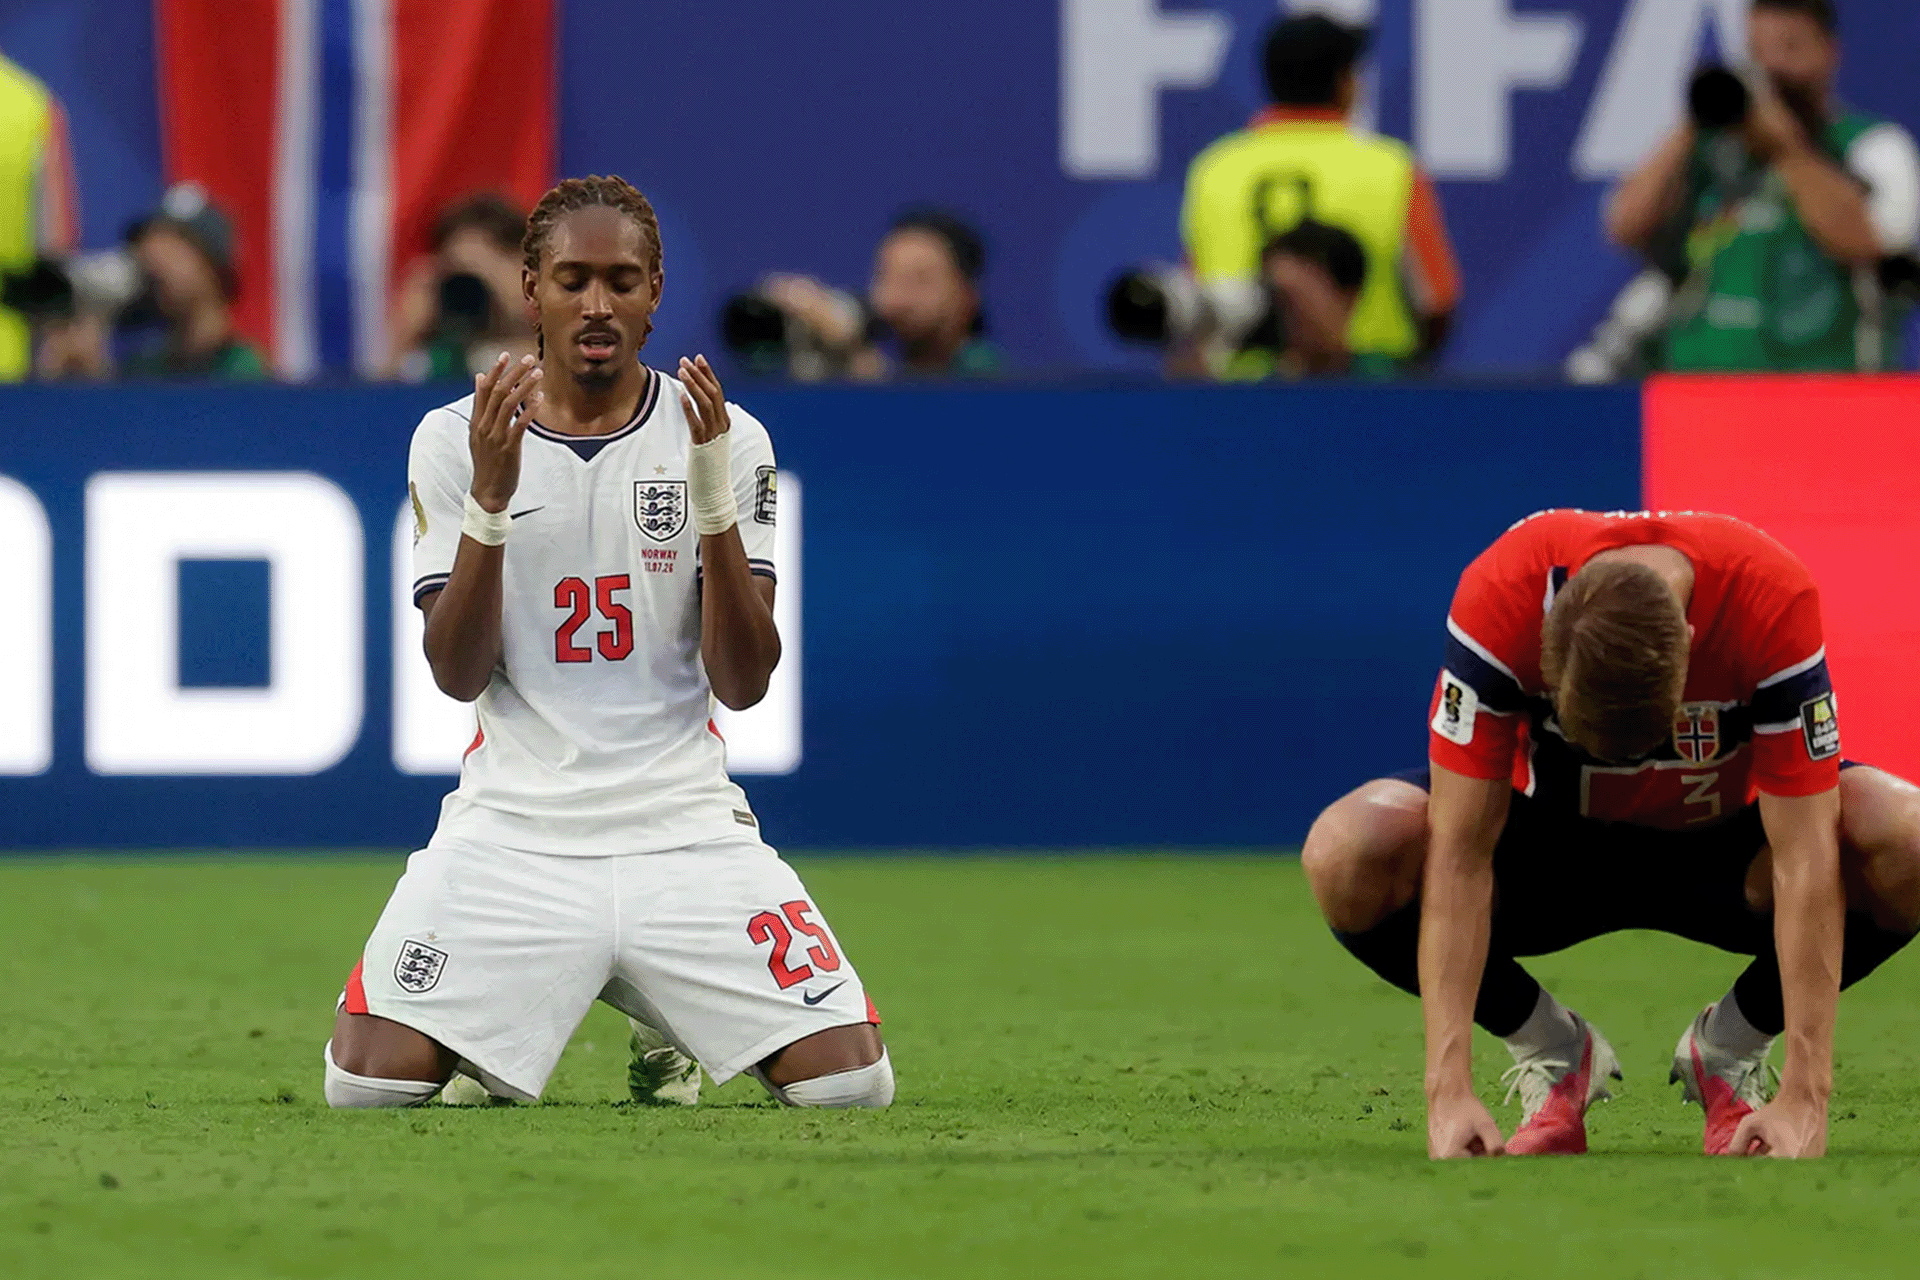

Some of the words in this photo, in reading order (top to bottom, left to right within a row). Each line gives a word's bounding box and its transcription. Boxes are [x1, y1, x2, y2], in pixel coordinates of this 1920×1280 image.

[1060, 0, 1752, 180] FF
[641, 548, 678, 560] NORWAY
[554, 573, 634, 663] 25
[1680, 771, 1722, 824] 3
[746, 900, 841, 990] 25
